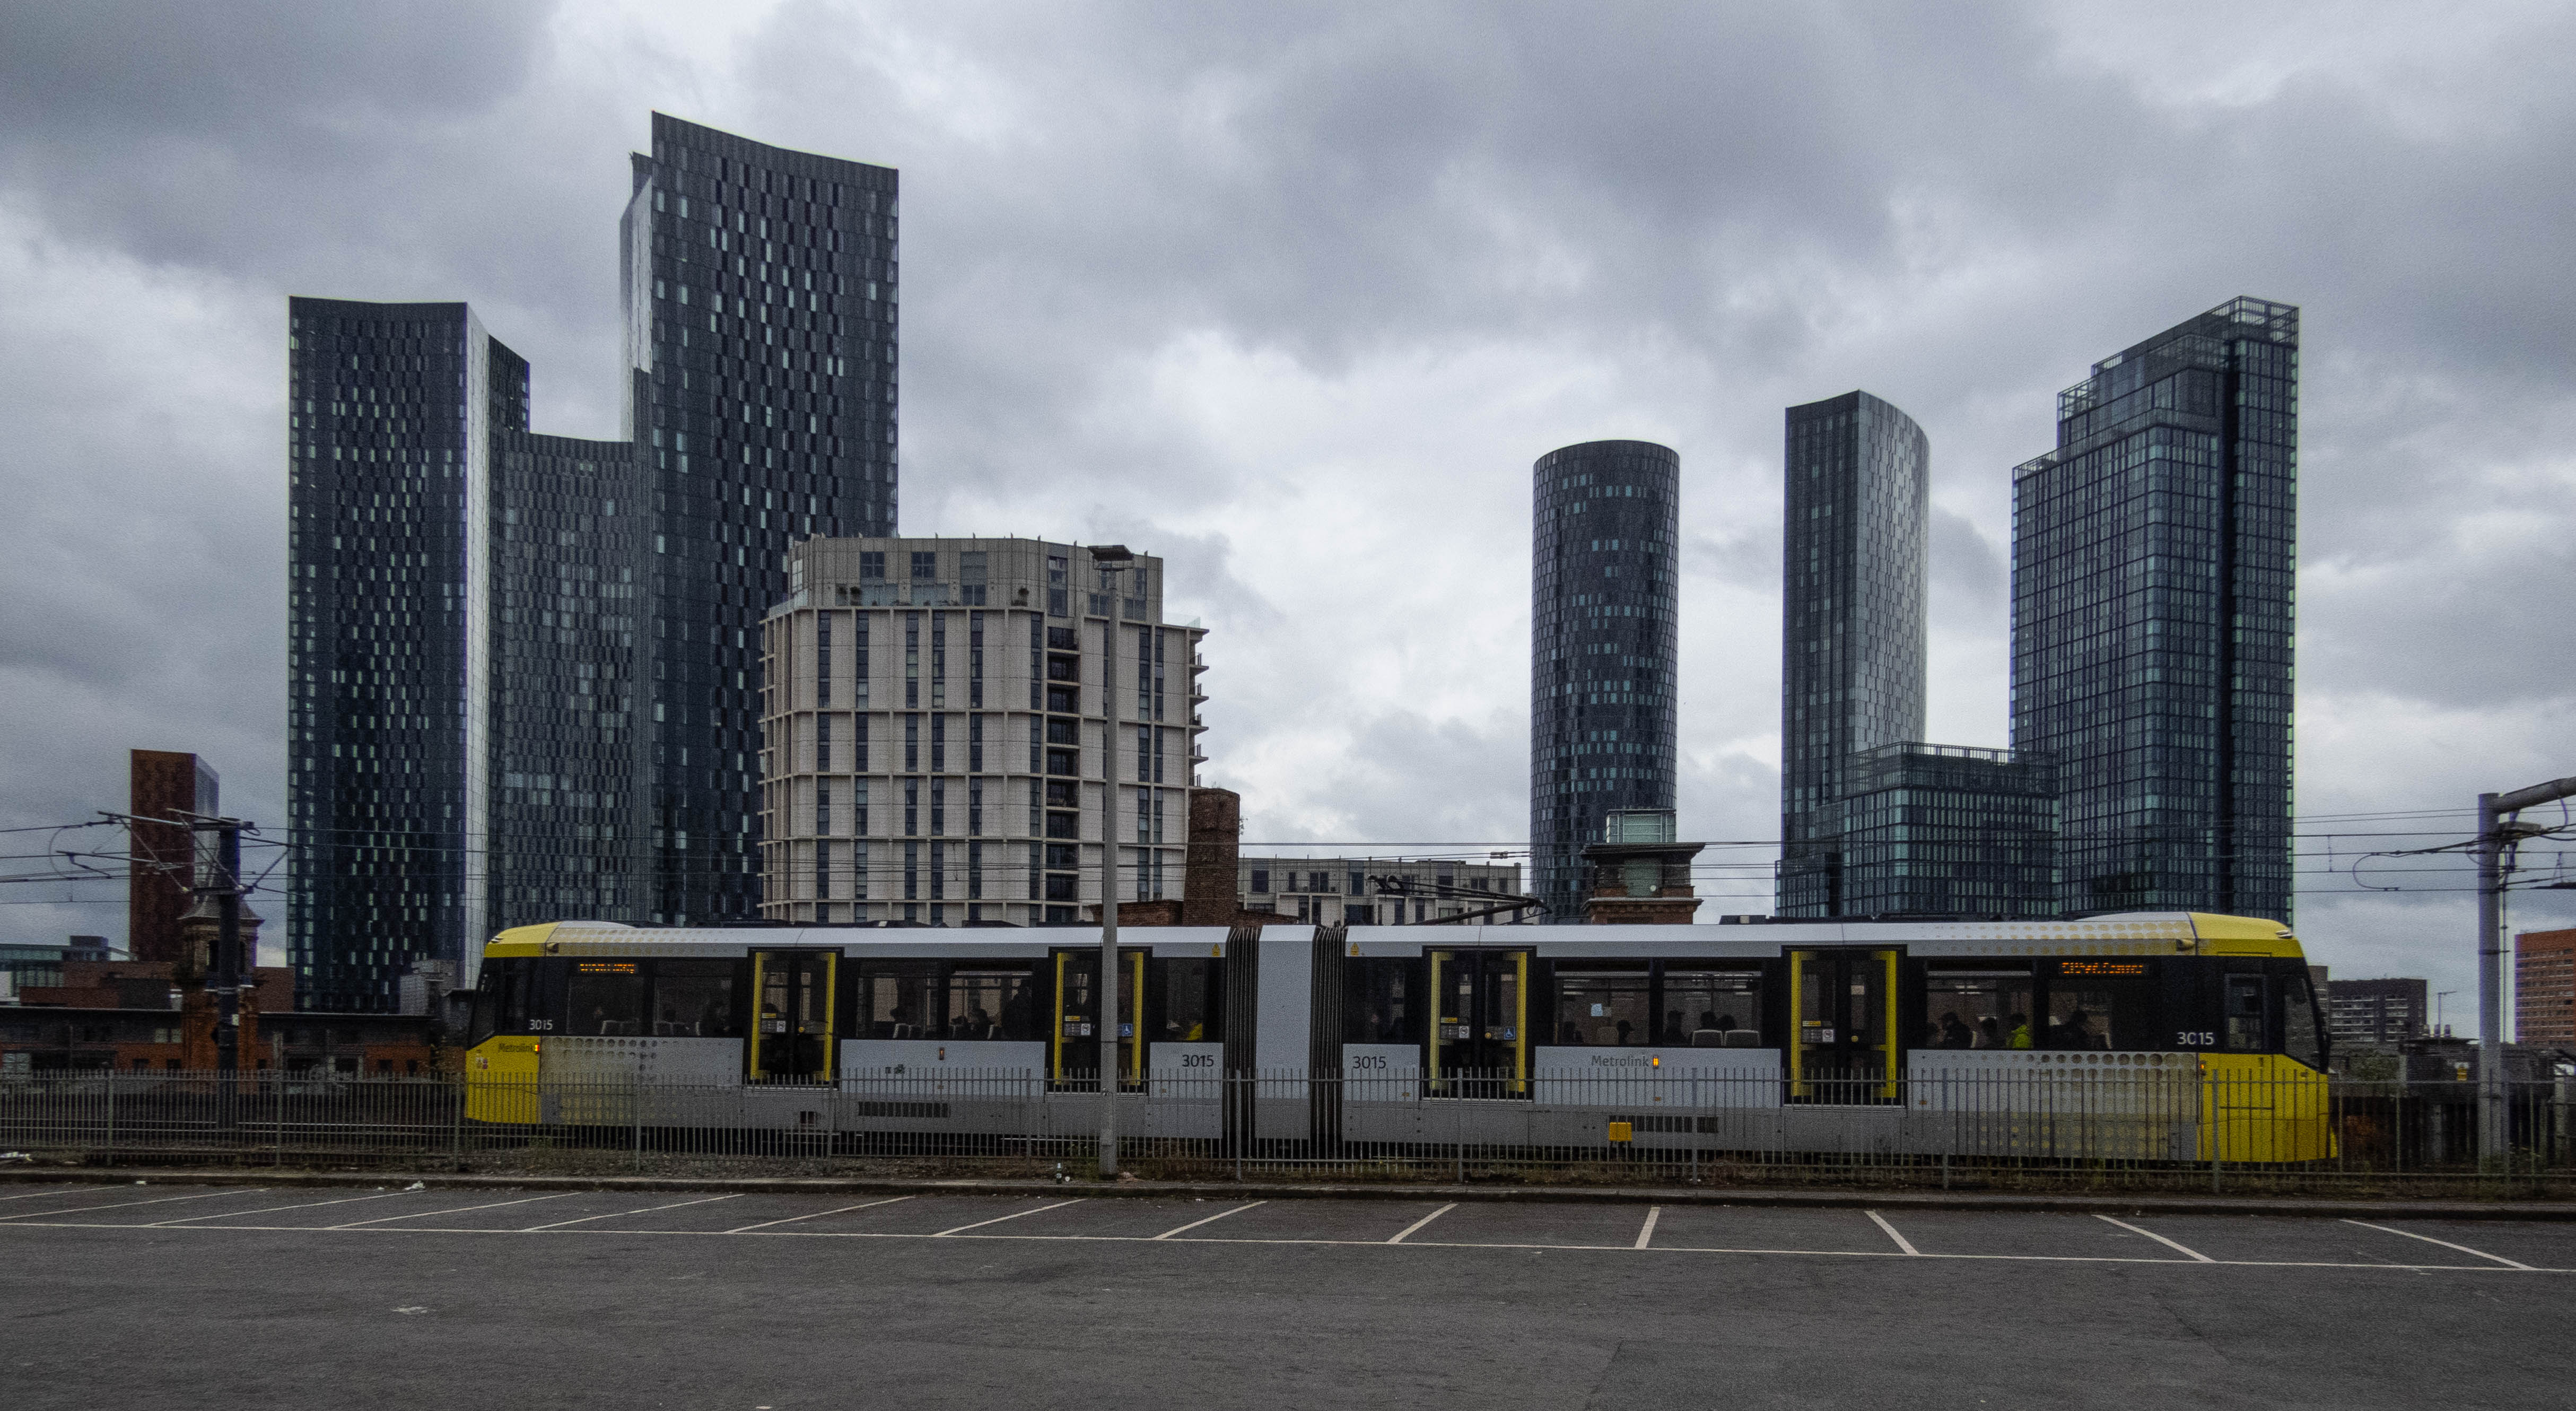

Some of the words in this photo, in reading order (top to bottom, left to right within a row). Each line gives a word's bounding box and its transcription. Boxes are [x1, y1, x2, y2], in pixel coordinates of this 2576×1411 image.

[529, 1018, 553, 1031] 3015
[2176, 1031, 2215, 1045] 3015
[1182, 1054, 1215, 1068] 3015
[1352, 1055, 1386, 1069] 3015
[1591, 1055, 1649, 1067] Metrolink
